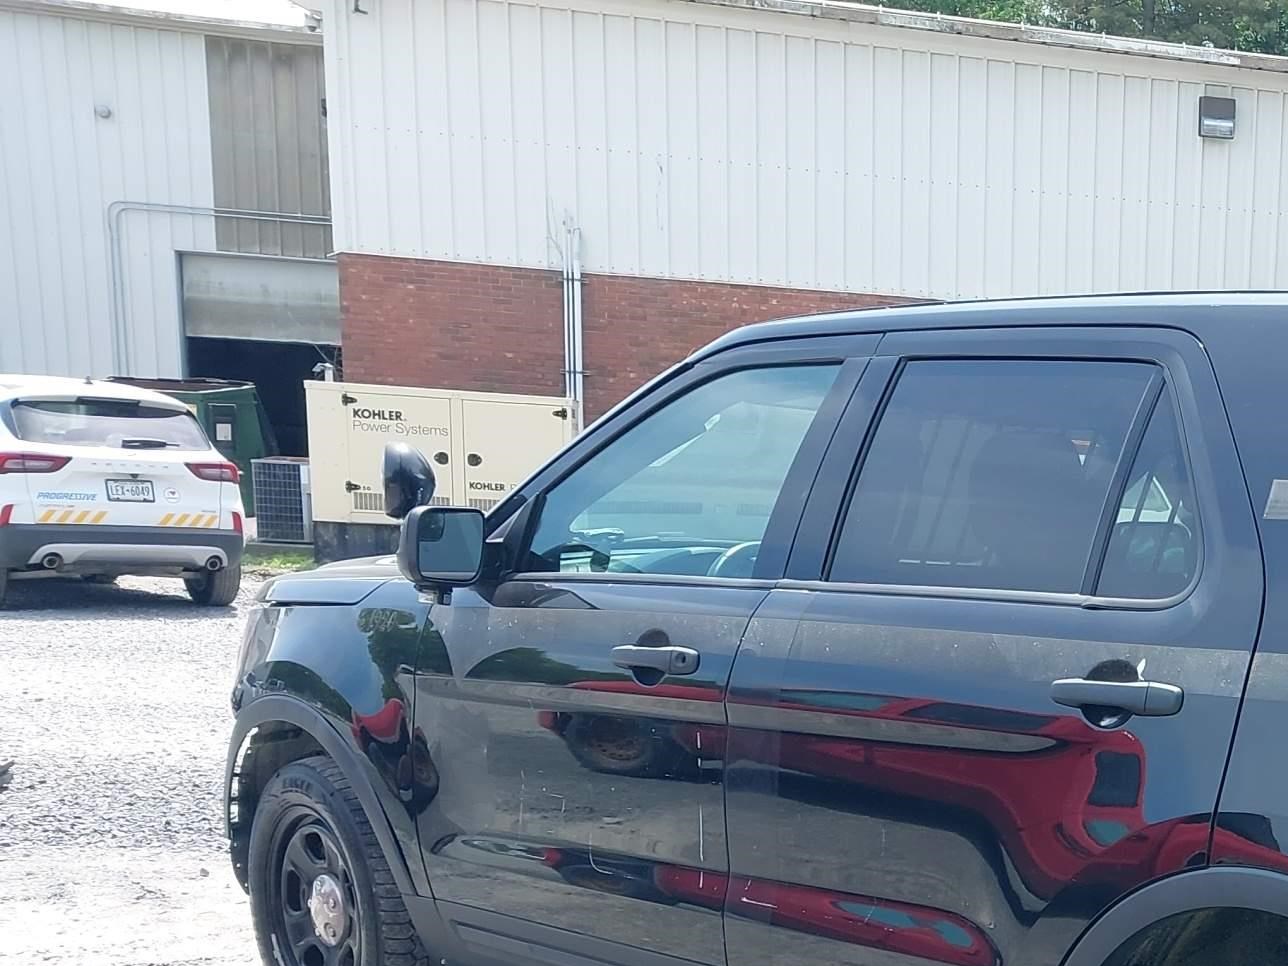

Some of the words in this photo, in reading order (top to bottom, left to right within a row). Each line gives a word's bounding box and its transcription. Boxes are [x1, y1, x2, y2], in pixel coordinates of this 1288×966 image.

[352, 408, 403, 421] KOHLER
[352, 420, 391, 433] Power
[395, 422, 449, 437] Systems
[469, 481, 506, 492] KOHLER
[37, 492, 97, 501] PROGRESSIVE
